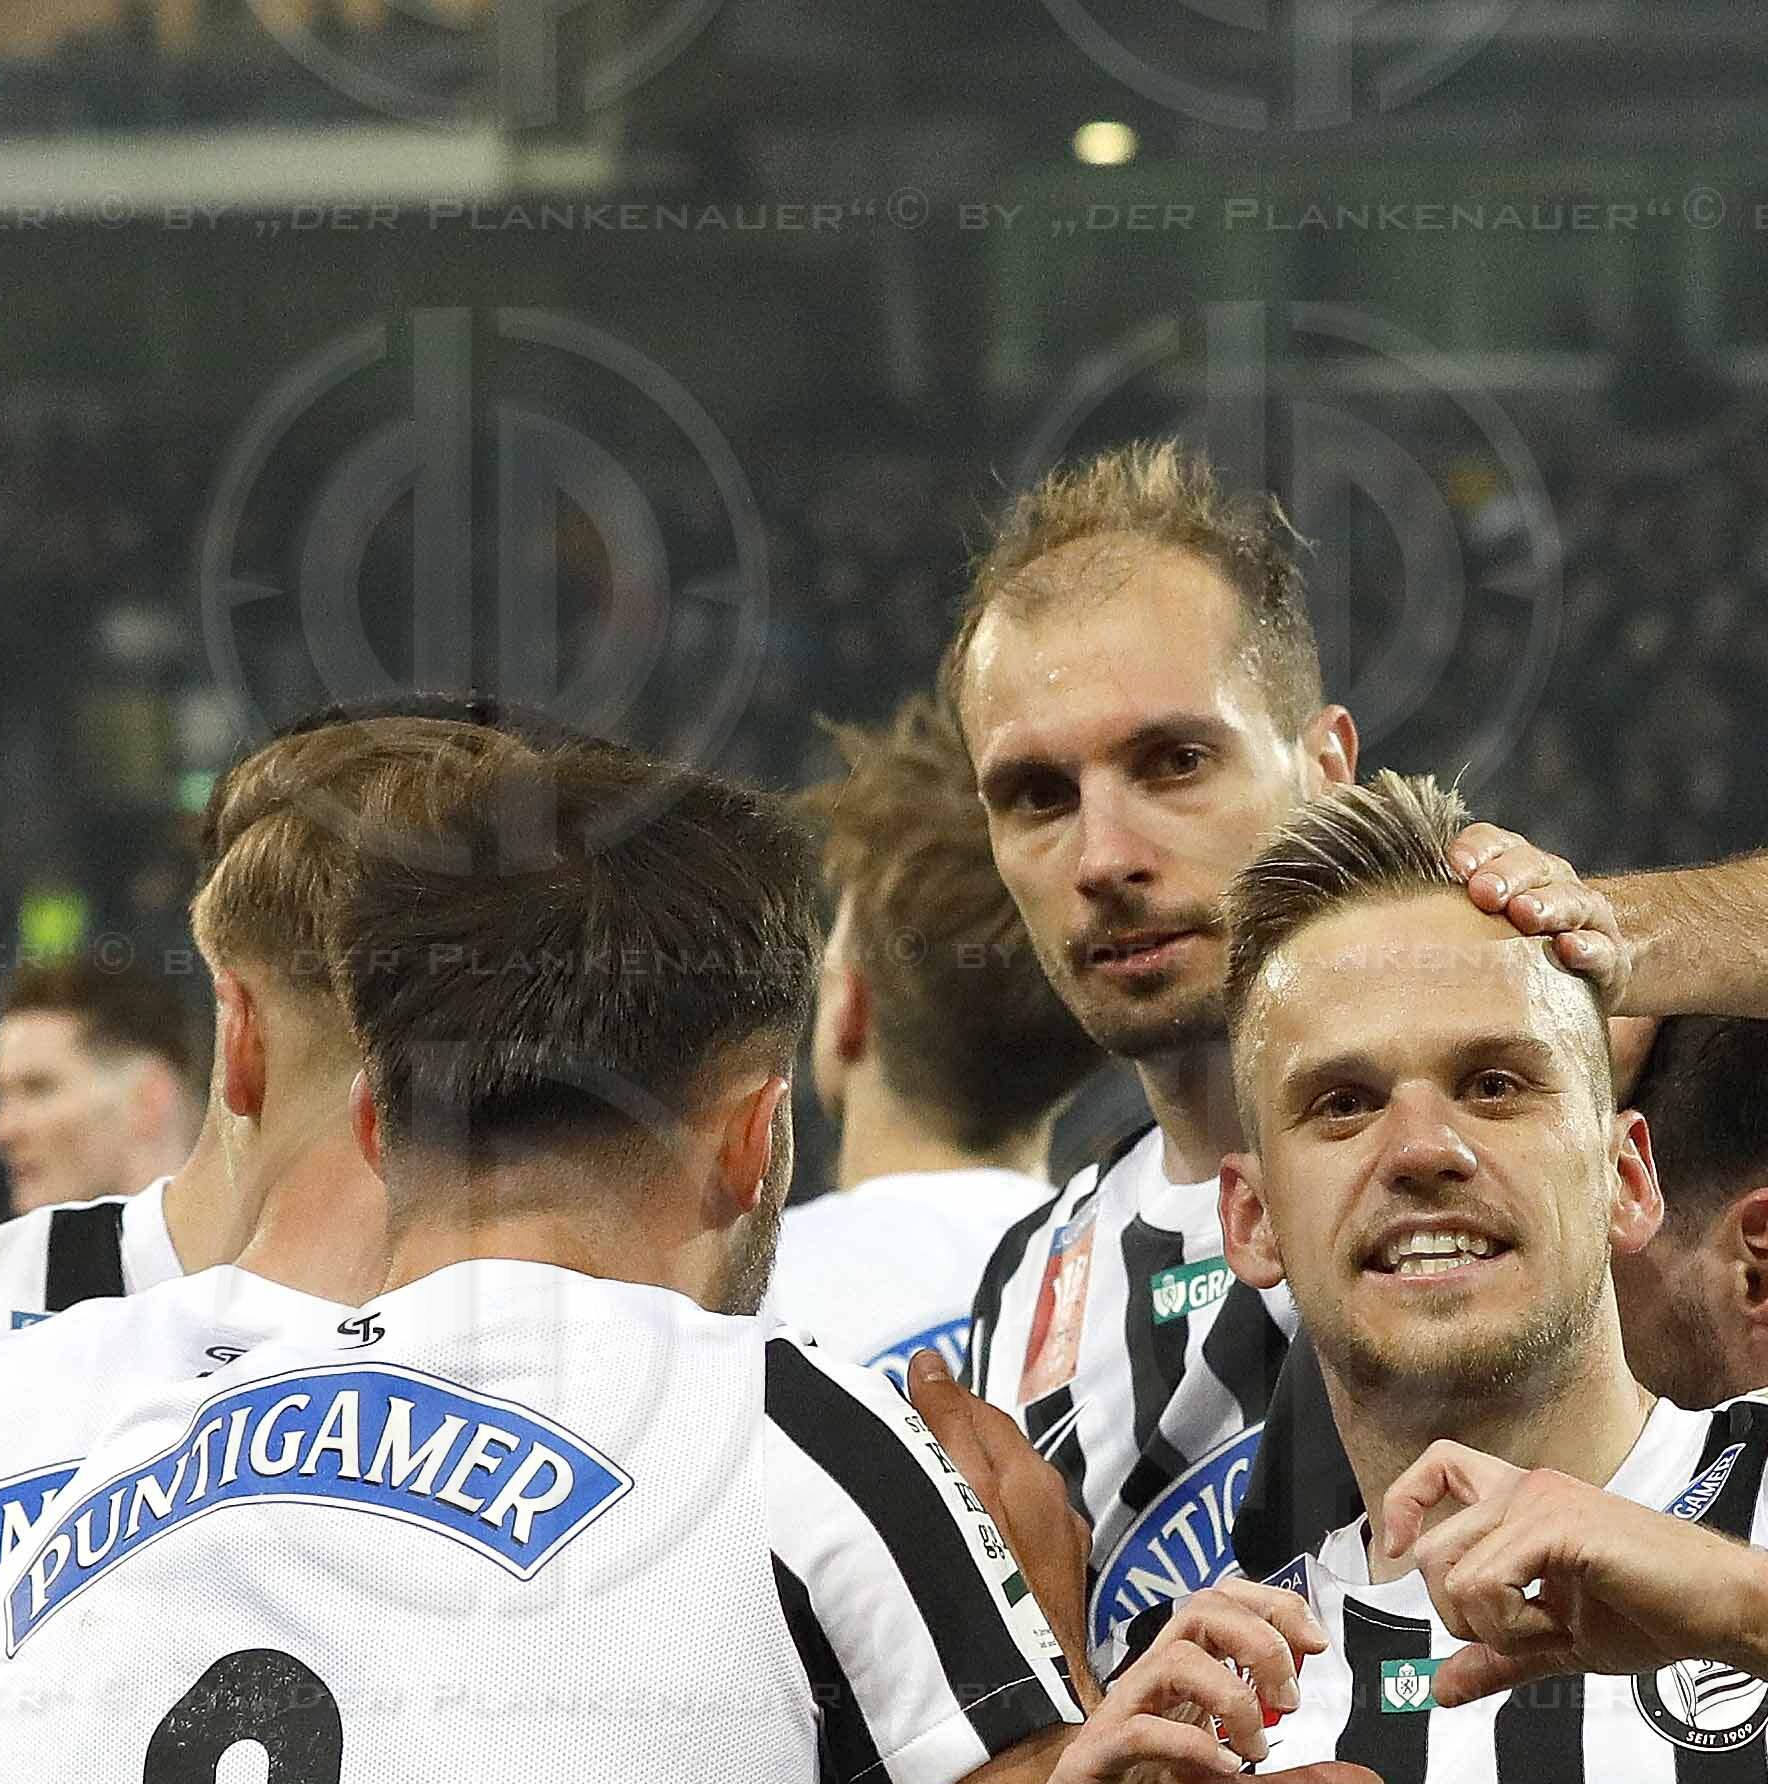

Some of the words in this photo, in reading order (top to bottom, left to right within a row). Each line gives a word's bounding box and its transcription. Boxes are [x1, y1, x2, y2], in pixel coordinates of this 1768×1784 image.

[26, 1391, 575, 1620] PUNTIGAMER
[1685, 1730, 1716, 1746] SEIT
[1722, 1722, 1754, 1745] 1909
